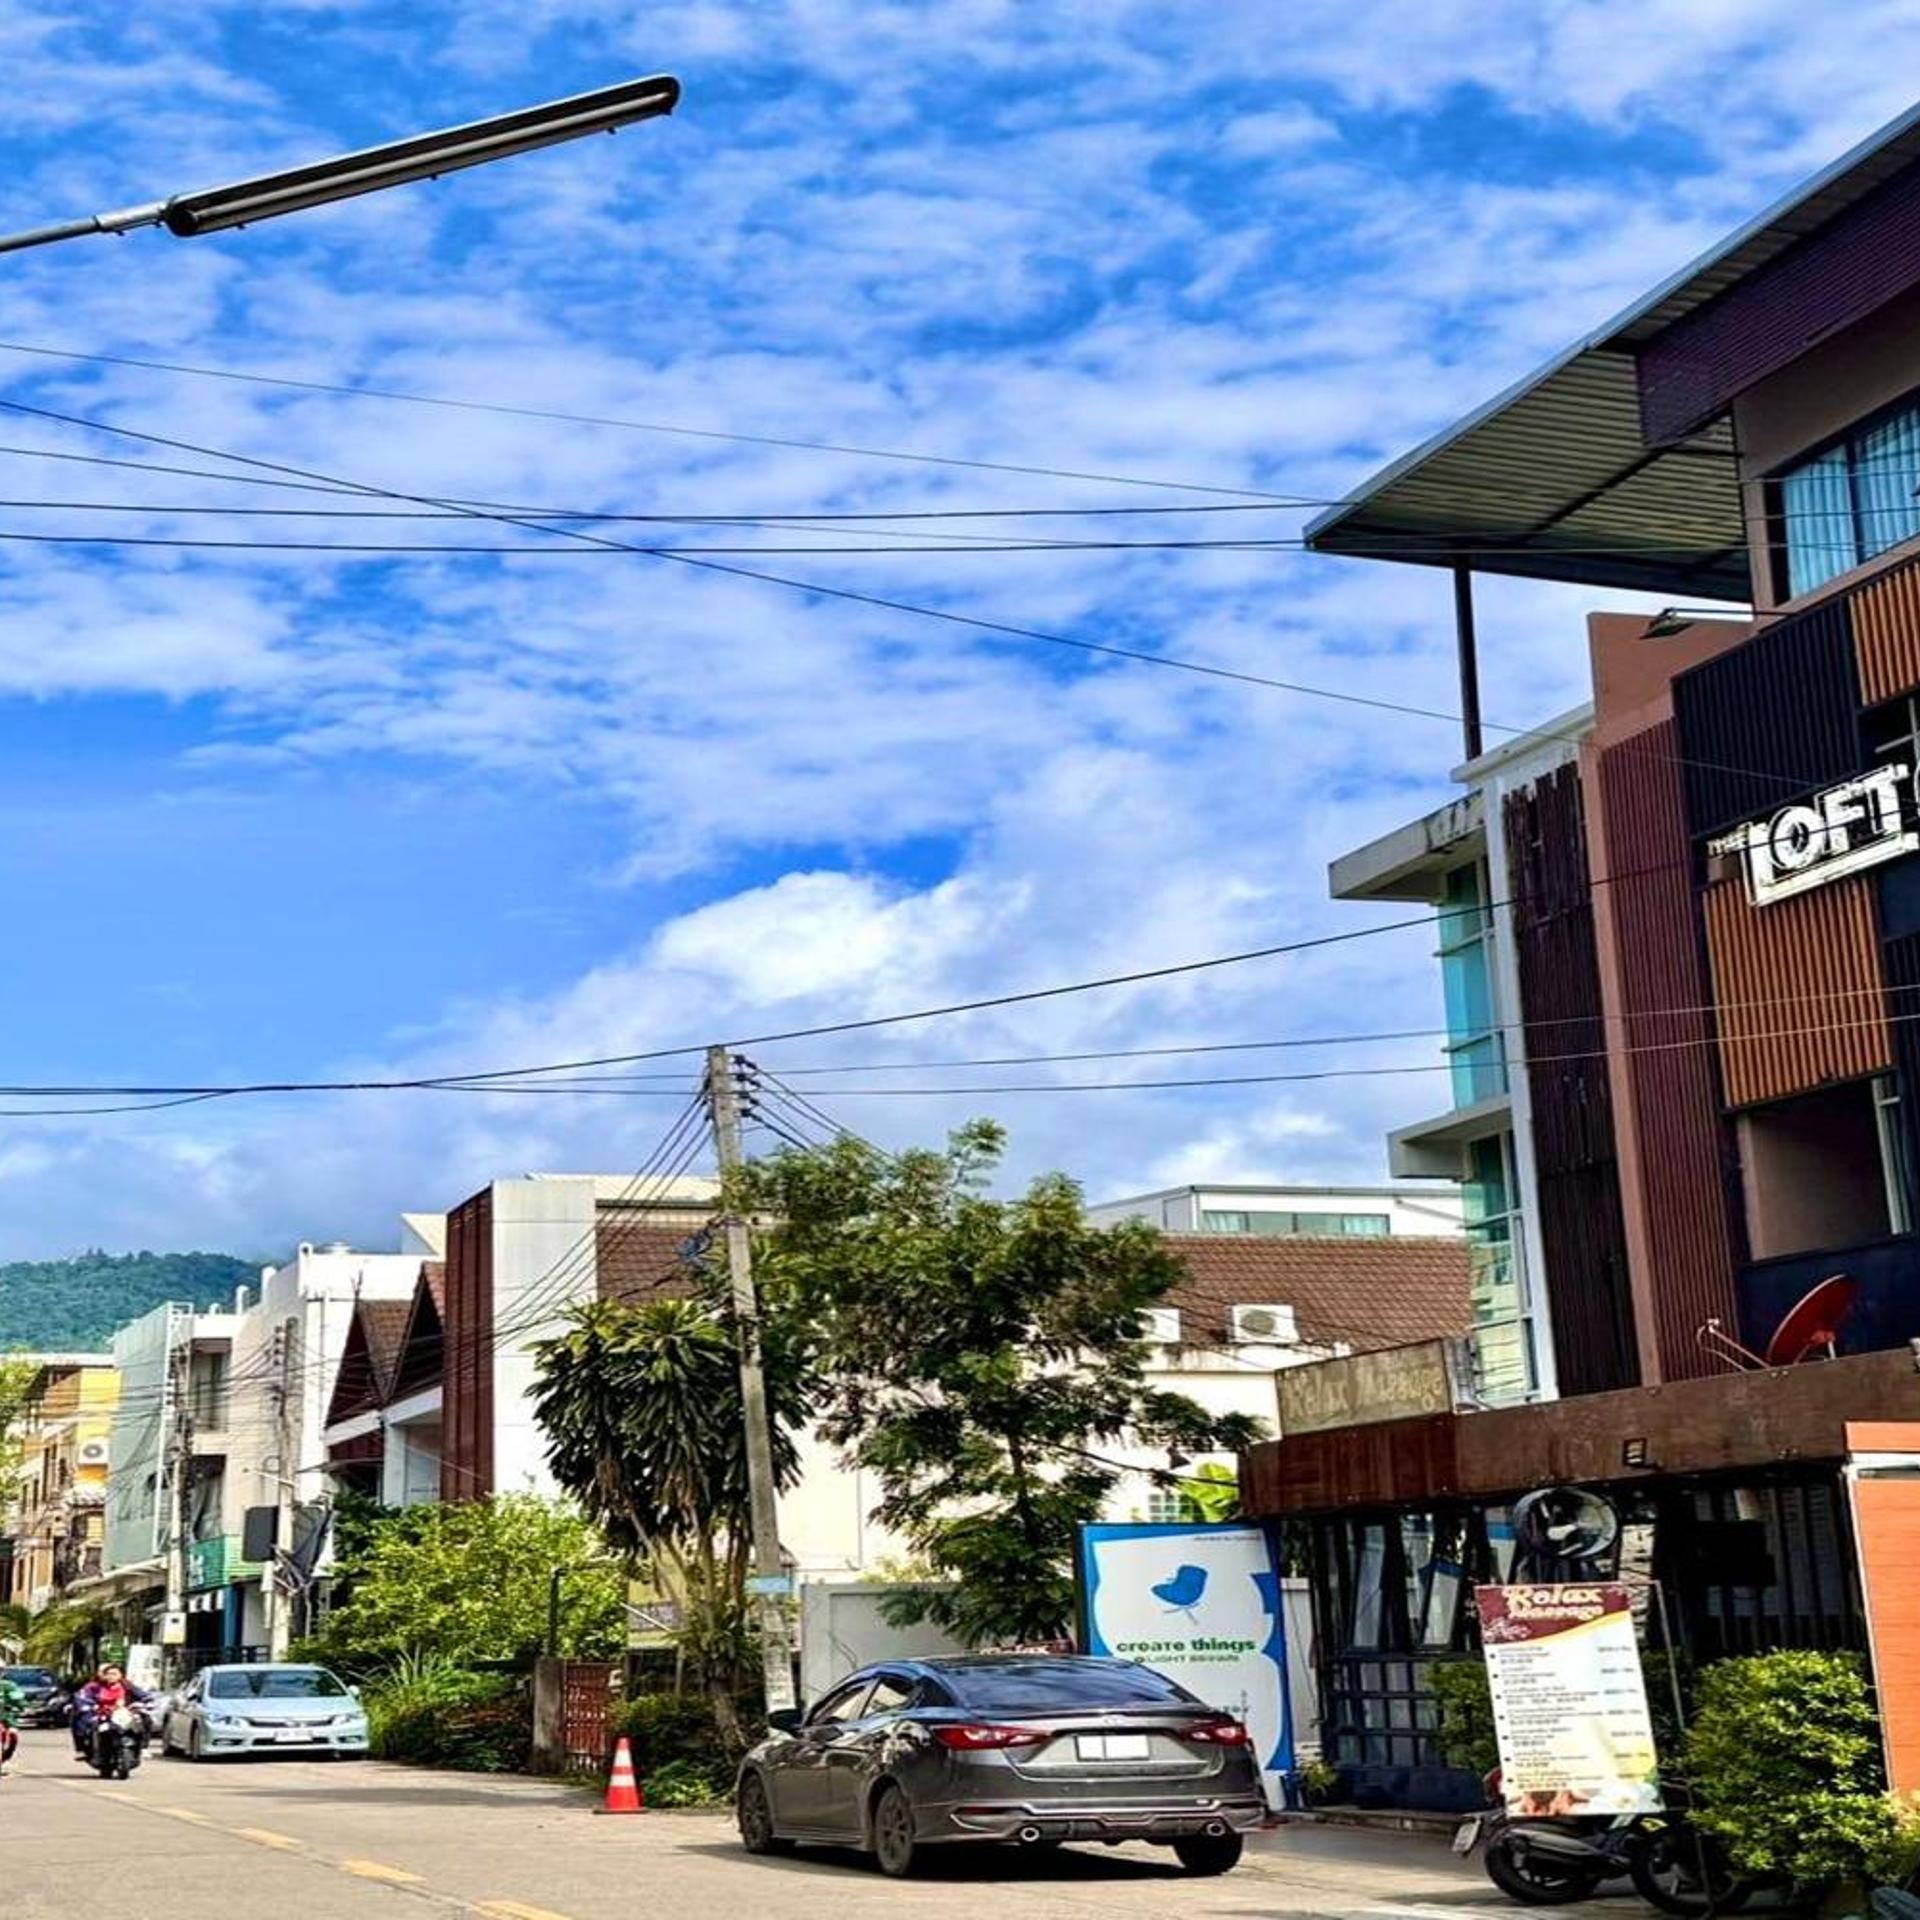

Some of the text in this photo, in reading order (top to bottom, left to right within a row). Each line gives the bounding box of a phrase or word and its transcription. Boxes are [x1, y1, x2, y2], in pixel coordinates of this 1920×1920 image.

[1740, 763, 1919, 906] LOFT
[1502, 1585, 1604, 1610] Relax
[1117, 1637, 1256, 1652] create things
